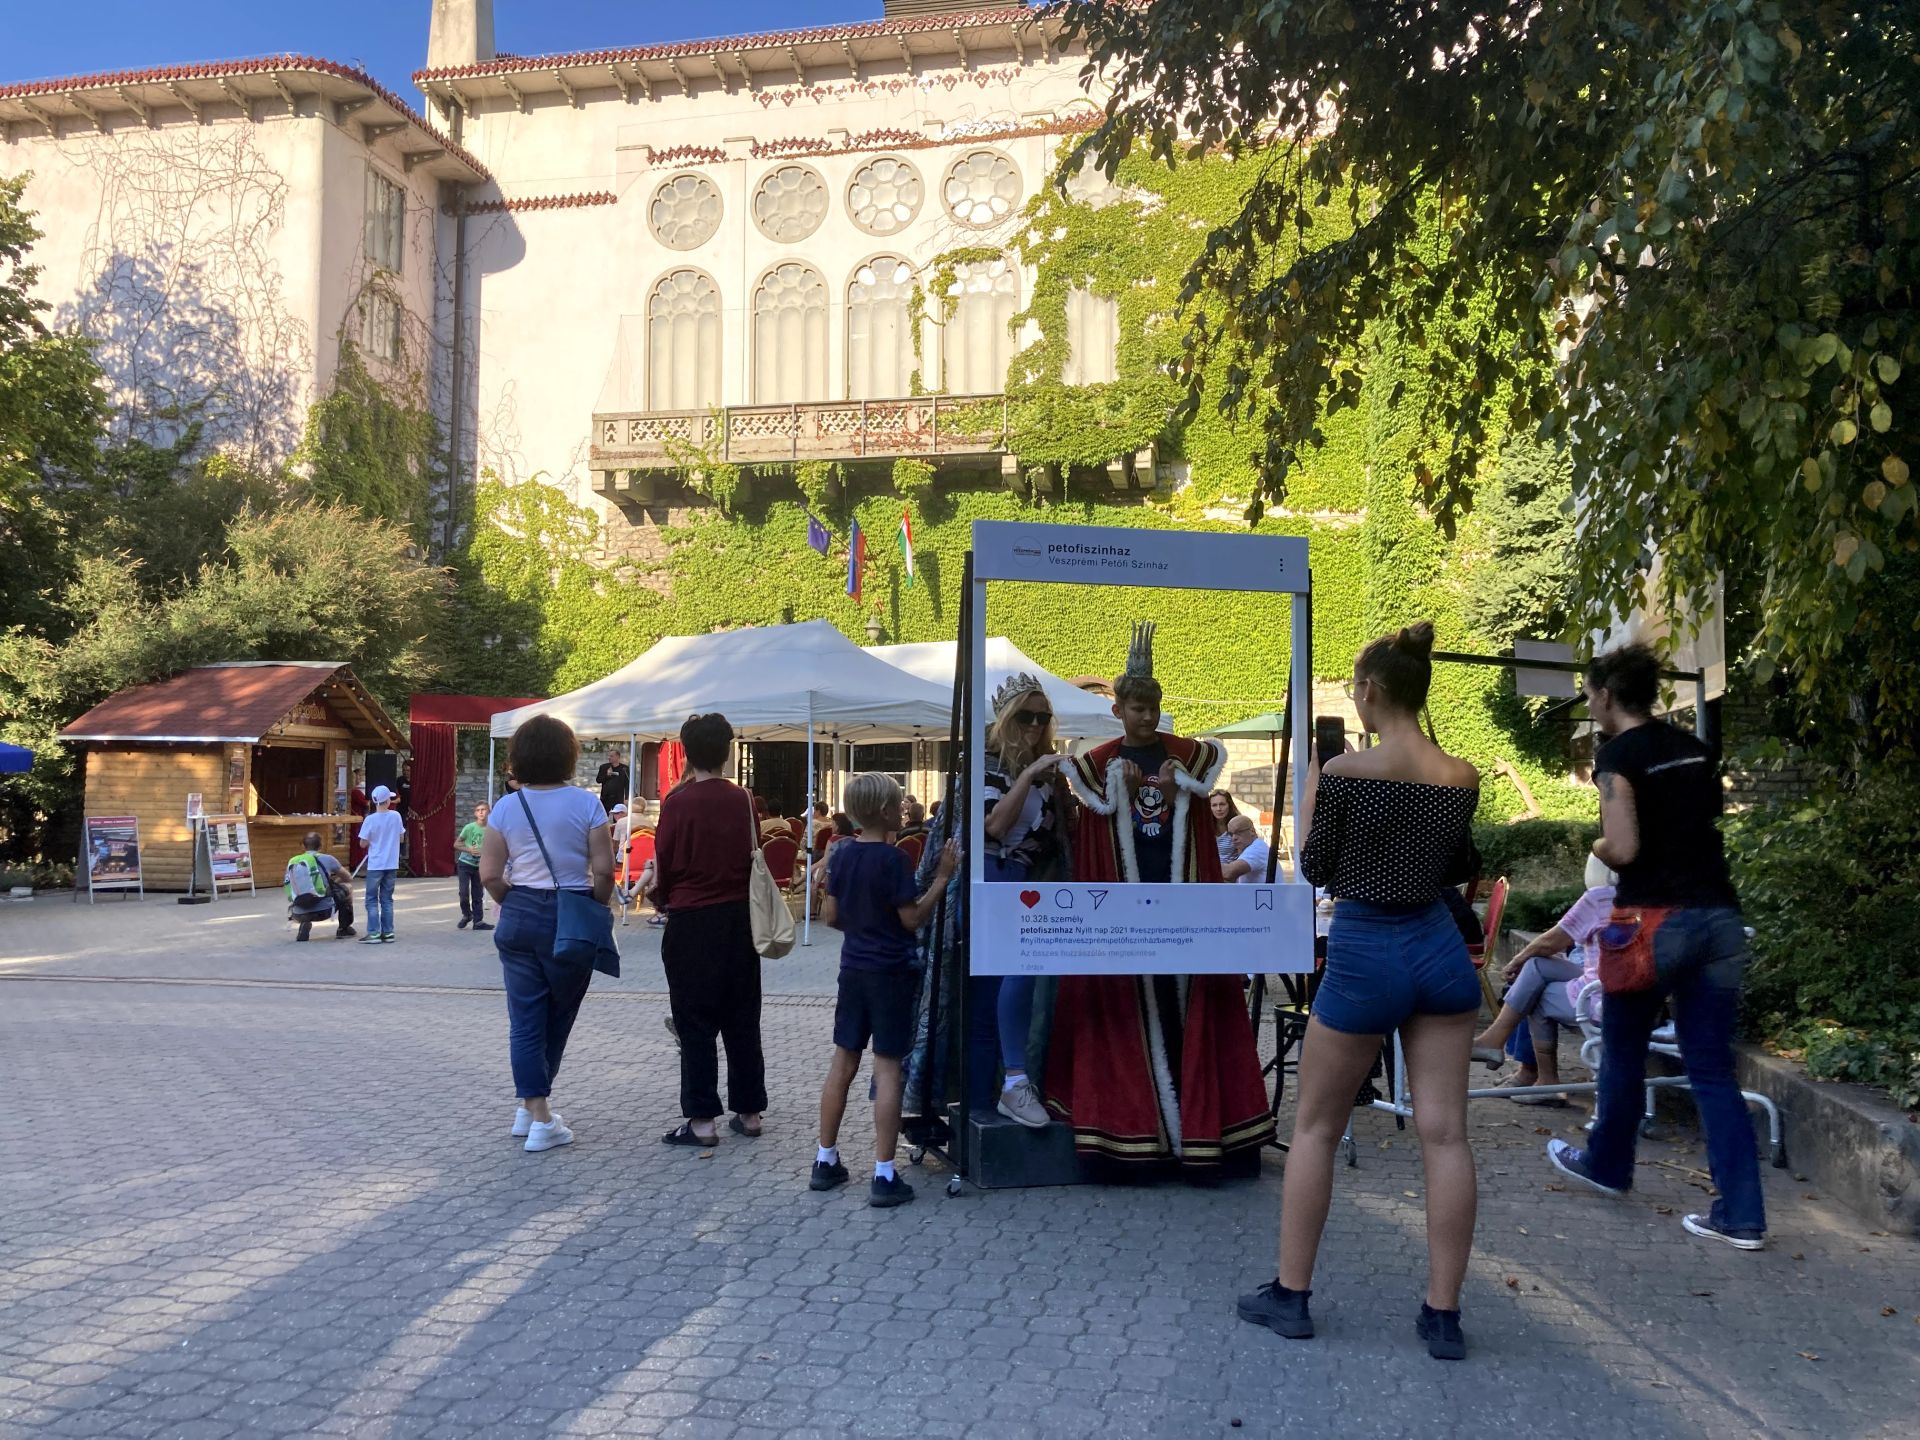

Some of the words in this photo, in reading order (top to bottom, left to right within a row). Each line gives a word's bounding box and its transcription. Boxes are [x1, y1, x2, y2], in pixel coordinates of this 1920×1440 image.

[1048, 543, 1131, 557] petofiszinhaz
[1048, 555, 1098, 567] Veszprémi
[1101, 557, 1128, 569] Petőfi
[1020, 914, 1048, 923] 10.328
[1050, 914, 1084, 925] személy
[1020, 926, 1073, 935] petofiszinhaz
[1094, 927, 1108, 935] nap
[1110, 926, 1128, 934] 2021
[1020, 949, 1031, 957] Az
